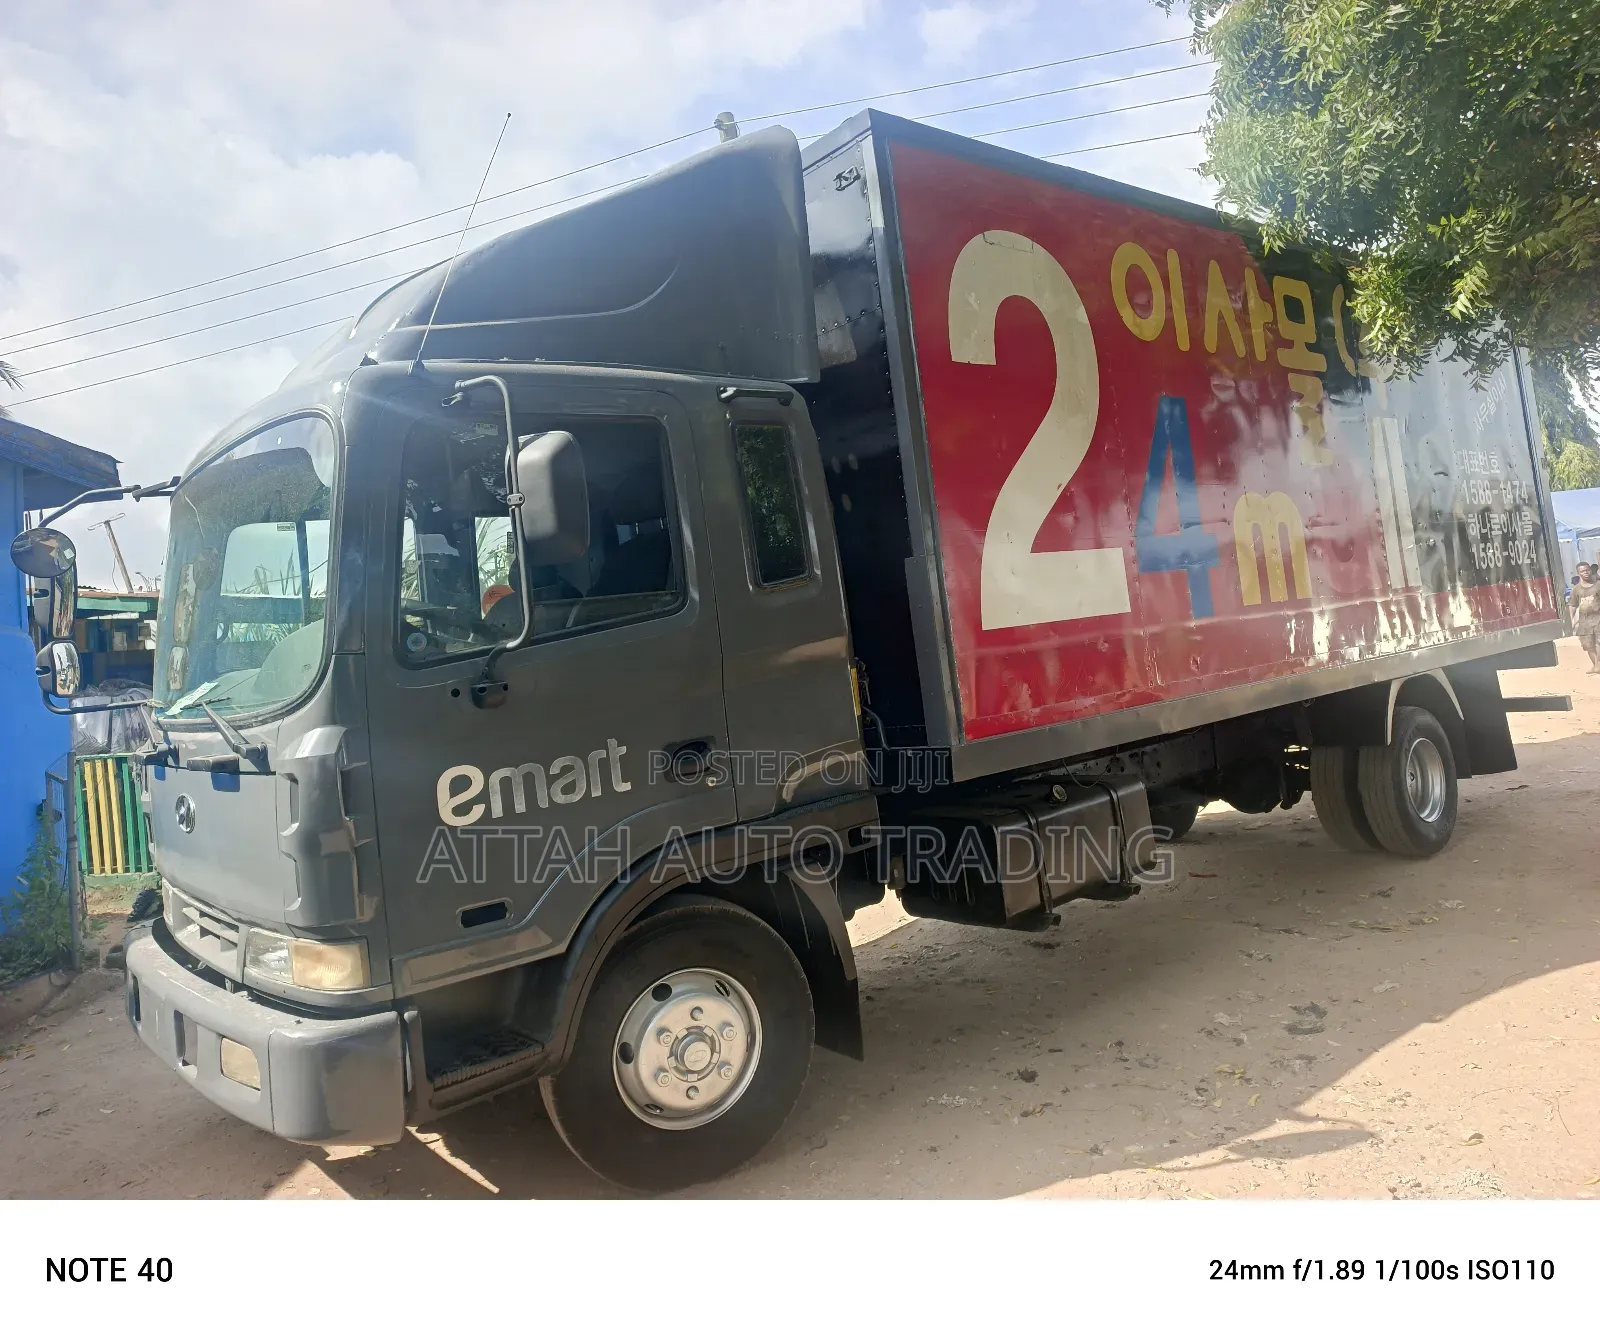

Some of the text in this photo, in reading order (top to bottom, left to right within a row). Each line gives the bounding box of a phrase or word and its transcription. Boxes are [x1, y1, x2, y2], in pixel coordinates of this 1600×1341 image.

[1456, 449, 1500, 475] 대표번호
[1467, 508, 1533, 540] 하나로이사몰
[1470, 539, 1537, 570] 1588-9024
[436, 738, 632, 827] emart
